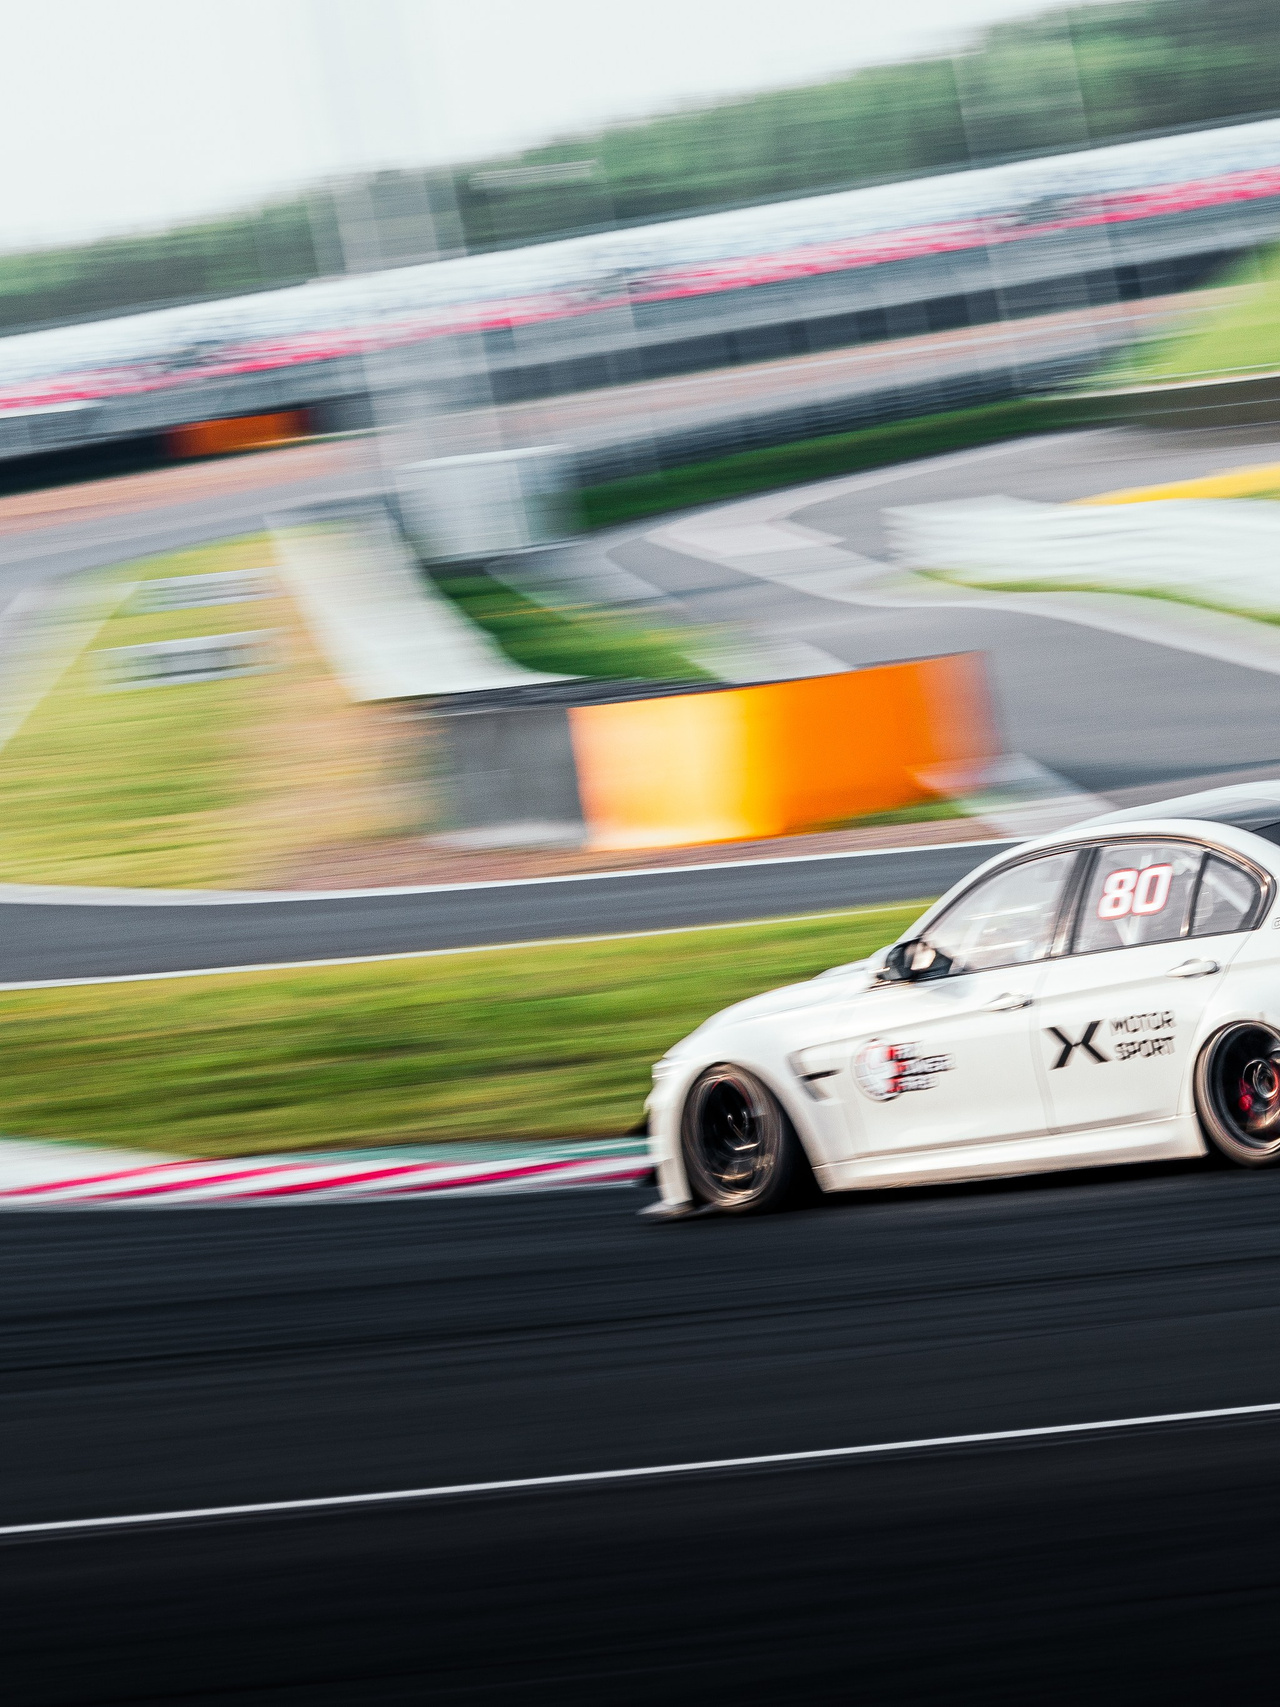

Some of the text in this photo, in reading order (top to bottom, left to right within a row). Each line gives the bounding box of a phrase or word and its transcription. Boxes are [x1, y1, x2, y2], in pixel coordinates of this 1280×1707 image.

[1097, 863, 1173, 920] 80
[1110, 1010, 1176, 1035] MOTOR
[1114, 1036, 1175, 1061] SPORT
